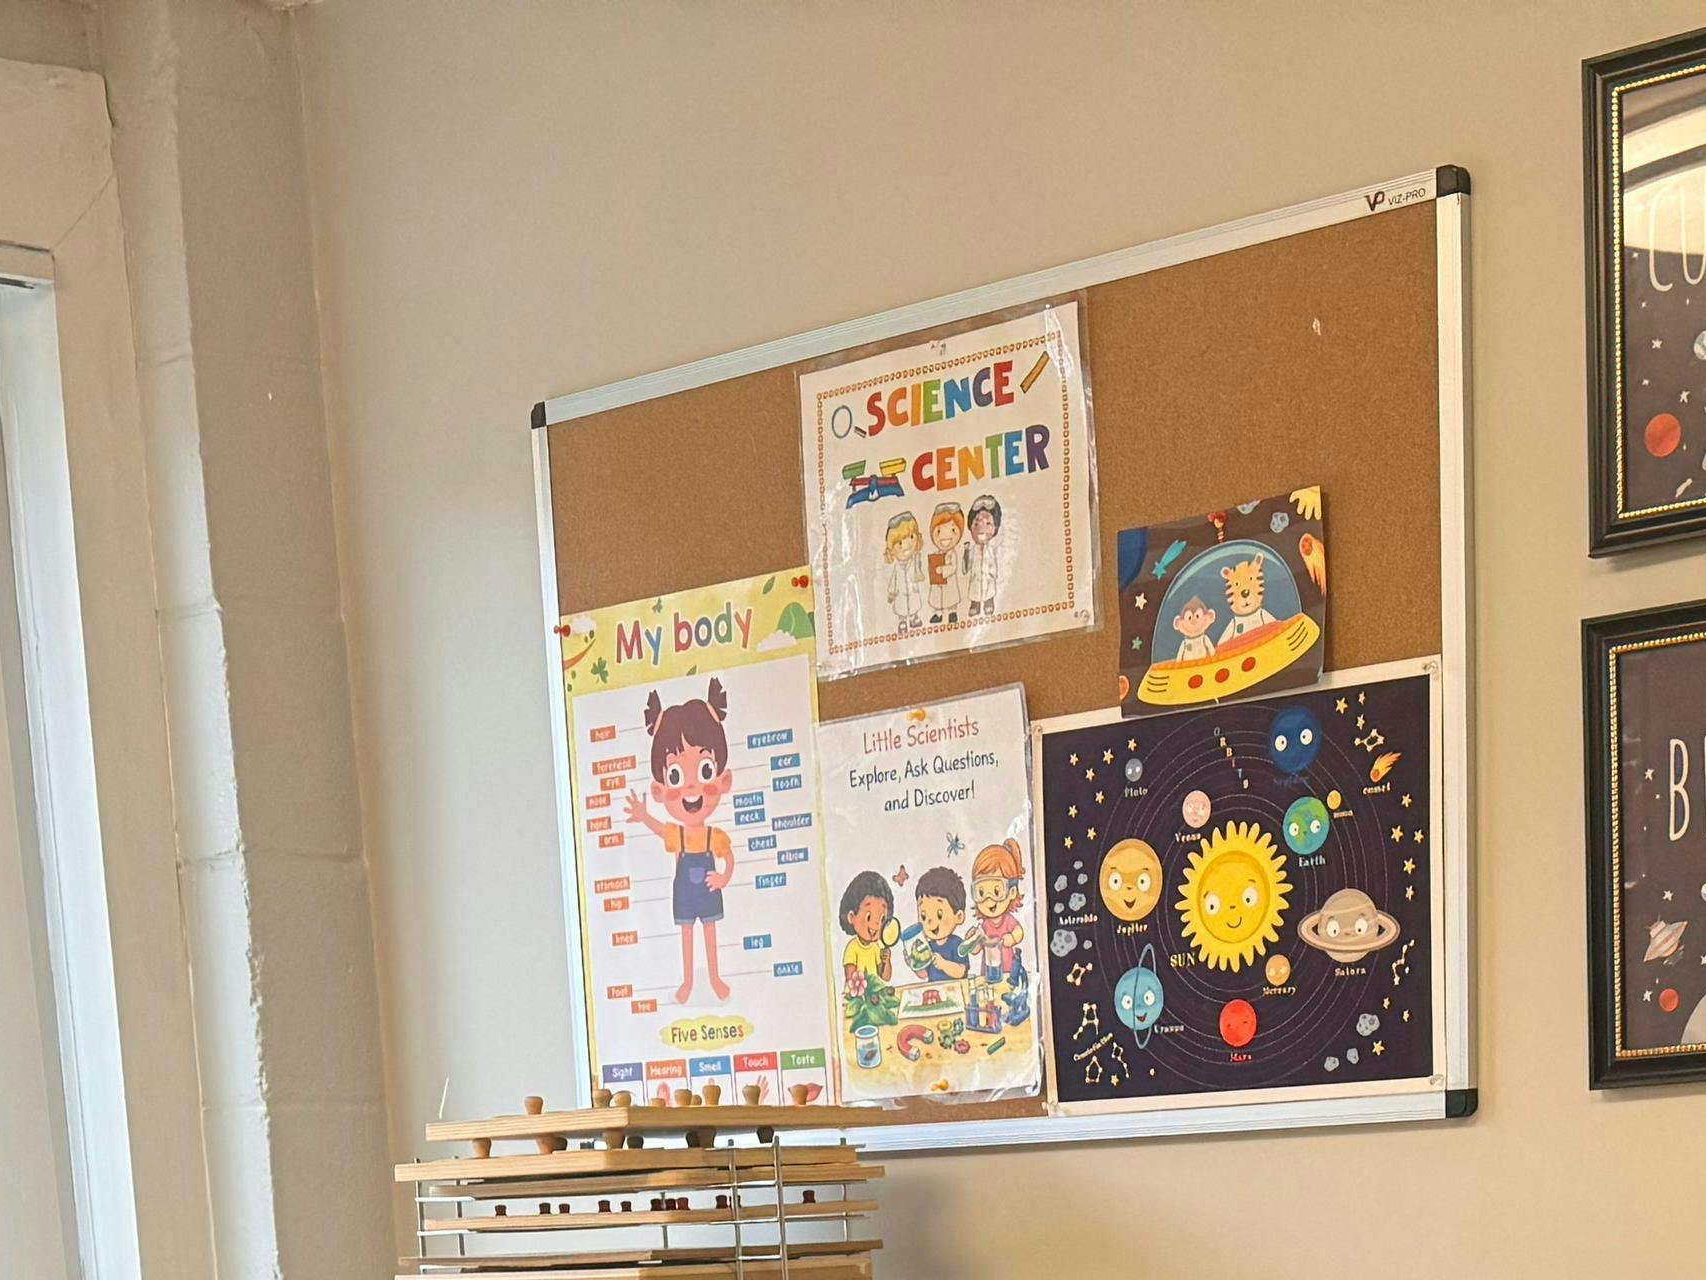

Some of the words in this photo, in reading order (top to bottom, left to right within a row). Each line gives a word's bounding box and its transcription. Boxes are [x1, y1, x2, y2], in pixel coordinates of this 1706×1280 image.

[1387, 187, 1427, 206] VIZ-PRO
[866, 359, 1015, 437] SCIENCE
[911, 423, 1051, 492] CENTER
[616, 619, 663, 667] My
[673, 600, 753, 653] body
[863, 727, 903, 755] Little
[906, 715, 980, 748] Scientists
[849, 765, 902, 791] Explore,
[904, 757, 929, 780] Ask
[933, 750, 1000, 775] Questions,
[884, 789, 909, 812] and
[914, 779, 976, 808] Discover!
[1298, 855, 1327, 868] Earth
[1169, 952, 1197, 969] SUN
[670, 1026, 698, 1044] Five
[700, 1023, 745, 1041] Senses
[697, 1060, 723, 1073] Smell
[742, 1055, 770, 1069] Touch
[790, 1053, 817, 1066] Taste
[612, 1066, 634, 1079] Sight
[649, 1063, 684, 1077] Hearing
